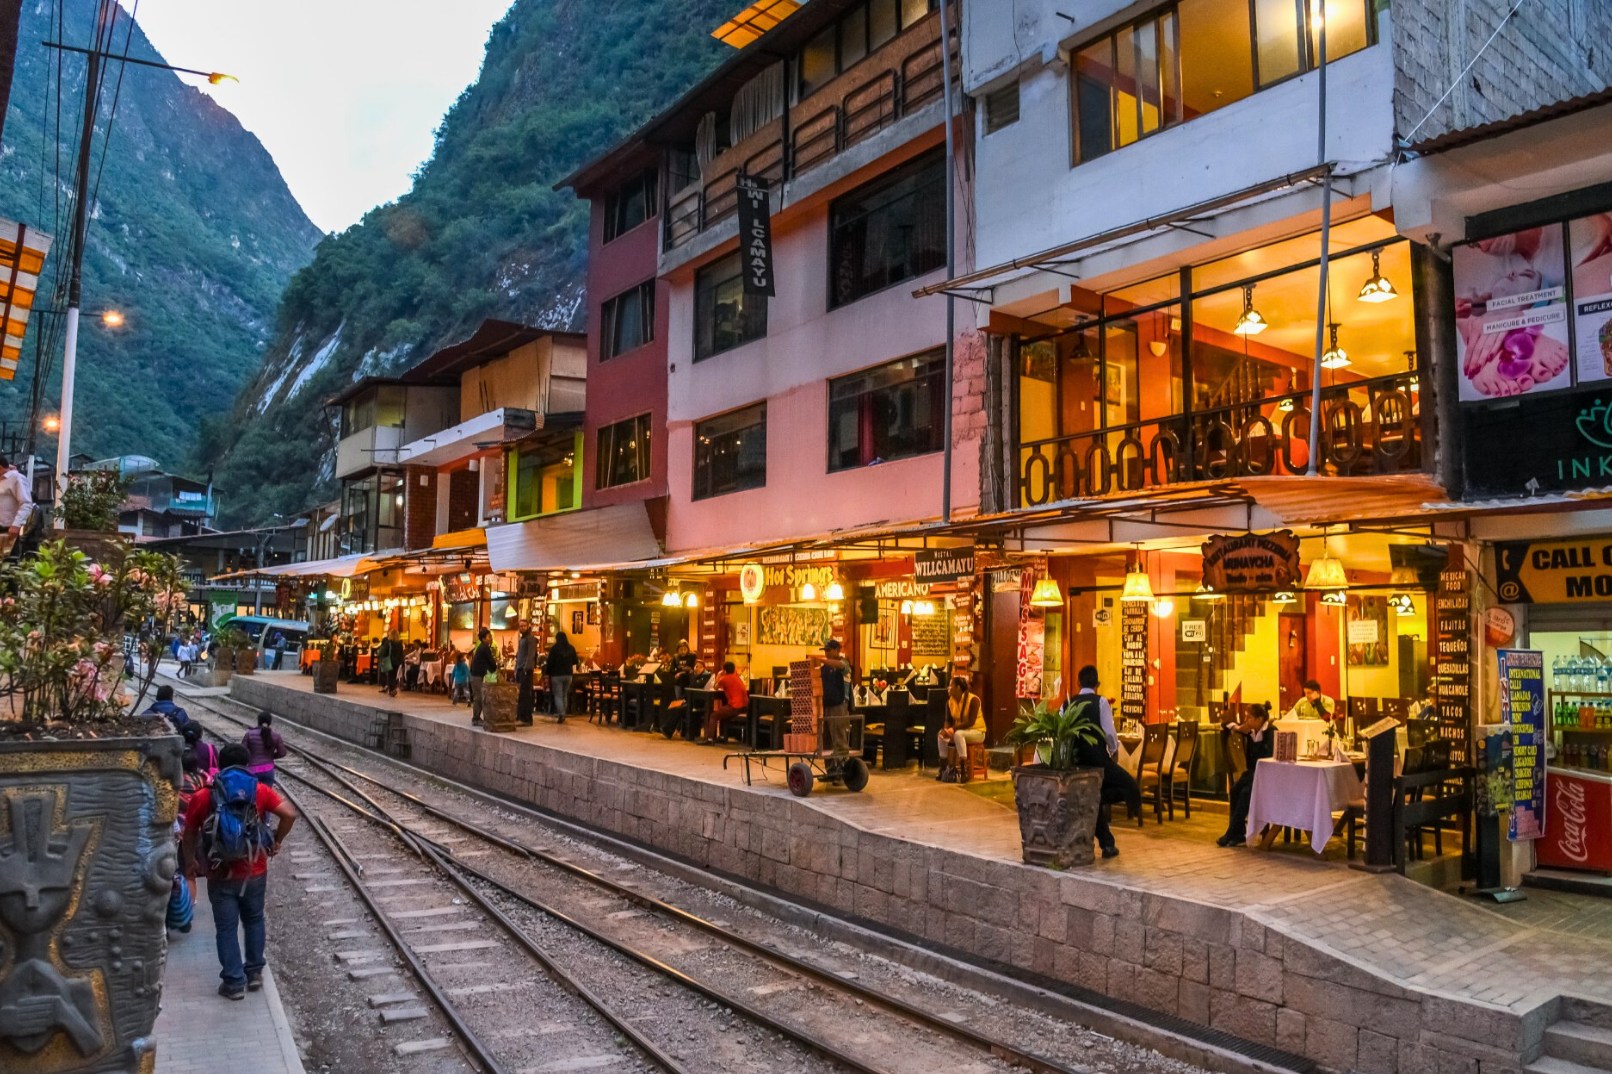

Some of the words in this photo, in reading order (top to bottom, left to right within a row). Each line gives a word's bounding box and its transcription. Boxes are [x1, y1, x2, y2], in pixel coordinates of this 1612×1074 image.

[1492, 297, 1516, 307] FACIAL
[1517, 290, 1556, 305] TREATMENT
[1584, 302, 1612, 313] REFLEX
[1486, 319, 1520, 331] MANICURE
[1521, 318, 1526, 326] &
[1527, 312, 1561, 325] PEDICURE
[1532, 547, 1596, 570] CALL
[914, 557, 974, 577] WILLCAMAYU
[765, 566, 785, 586] Hot
[786, 564, 833, 588] Springs
[1440, 571, 1466, 581] MEXICAN
[1446, 581, 1462, 591] FOOD
[1438, 598, 1469, 609] ENCHILADAS
[1440, 620, 1466, 631] FAJITAS
[1018, 572, 1032, 697] MASSAGE
[1439, 639, 1468, 653] TEQUEÑOS
[1437, 663, 1469, 675] QUESADILLAS
[1441, 706, 1463, 718] TACOS
[1440, 727, 1465, 739] NACHOS
